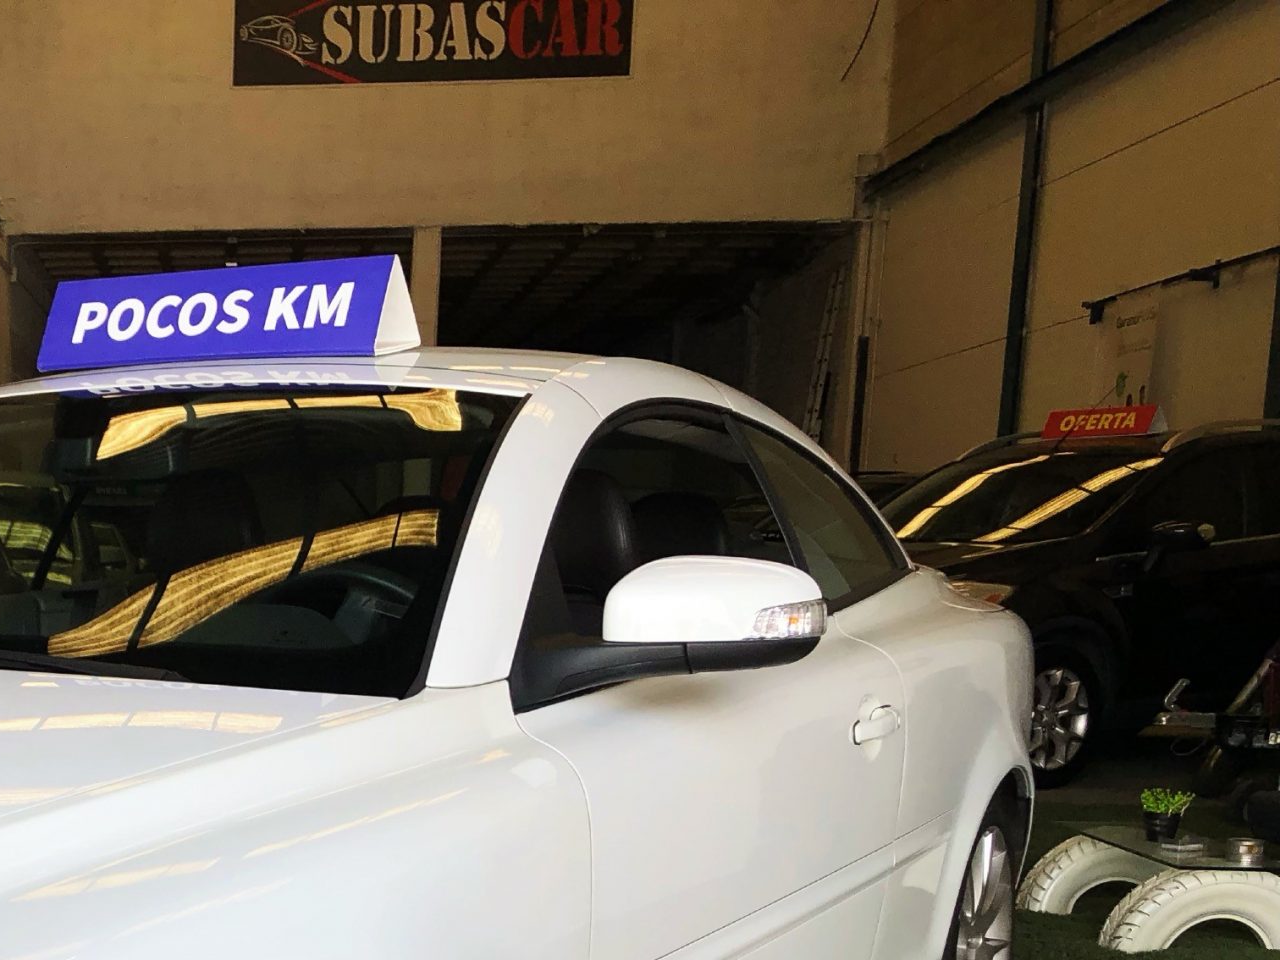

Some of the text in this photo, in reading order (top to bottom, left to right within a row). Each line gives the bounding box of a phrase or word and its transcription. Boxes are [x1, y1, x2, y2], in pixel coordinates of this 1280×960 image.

[321, 0, 623, 64] SUBASCAR
[71, 281, 355, 344] POCOS KM
[1060, 412, 1136, 431] OFERTA
